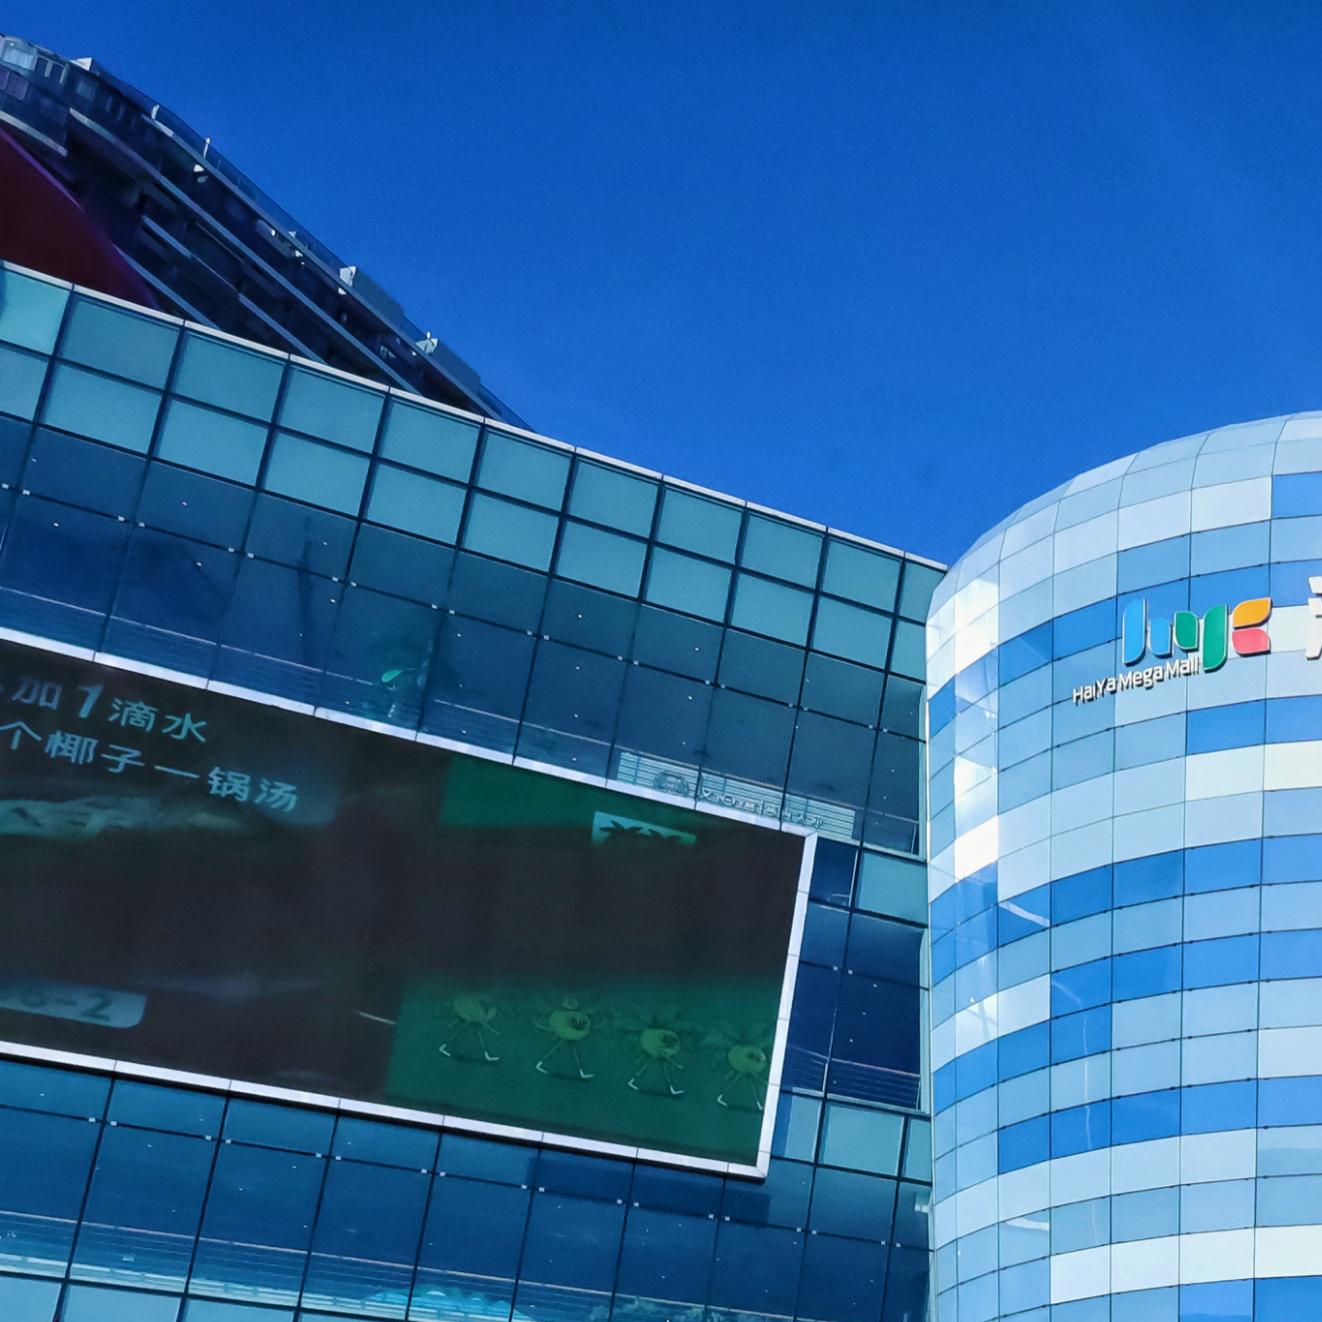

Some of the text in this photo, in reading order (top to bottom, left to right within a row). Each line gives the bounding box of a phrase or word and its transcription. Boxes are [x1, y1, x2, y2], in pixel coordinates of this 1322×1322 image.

[1118, 666, 1164, 690] Mega
[1164, 656, 1200, 680] Mall
[12, 677, 207, 742] 加1滴水
[0, 719, 299, 812] 个椰子一锅汤
